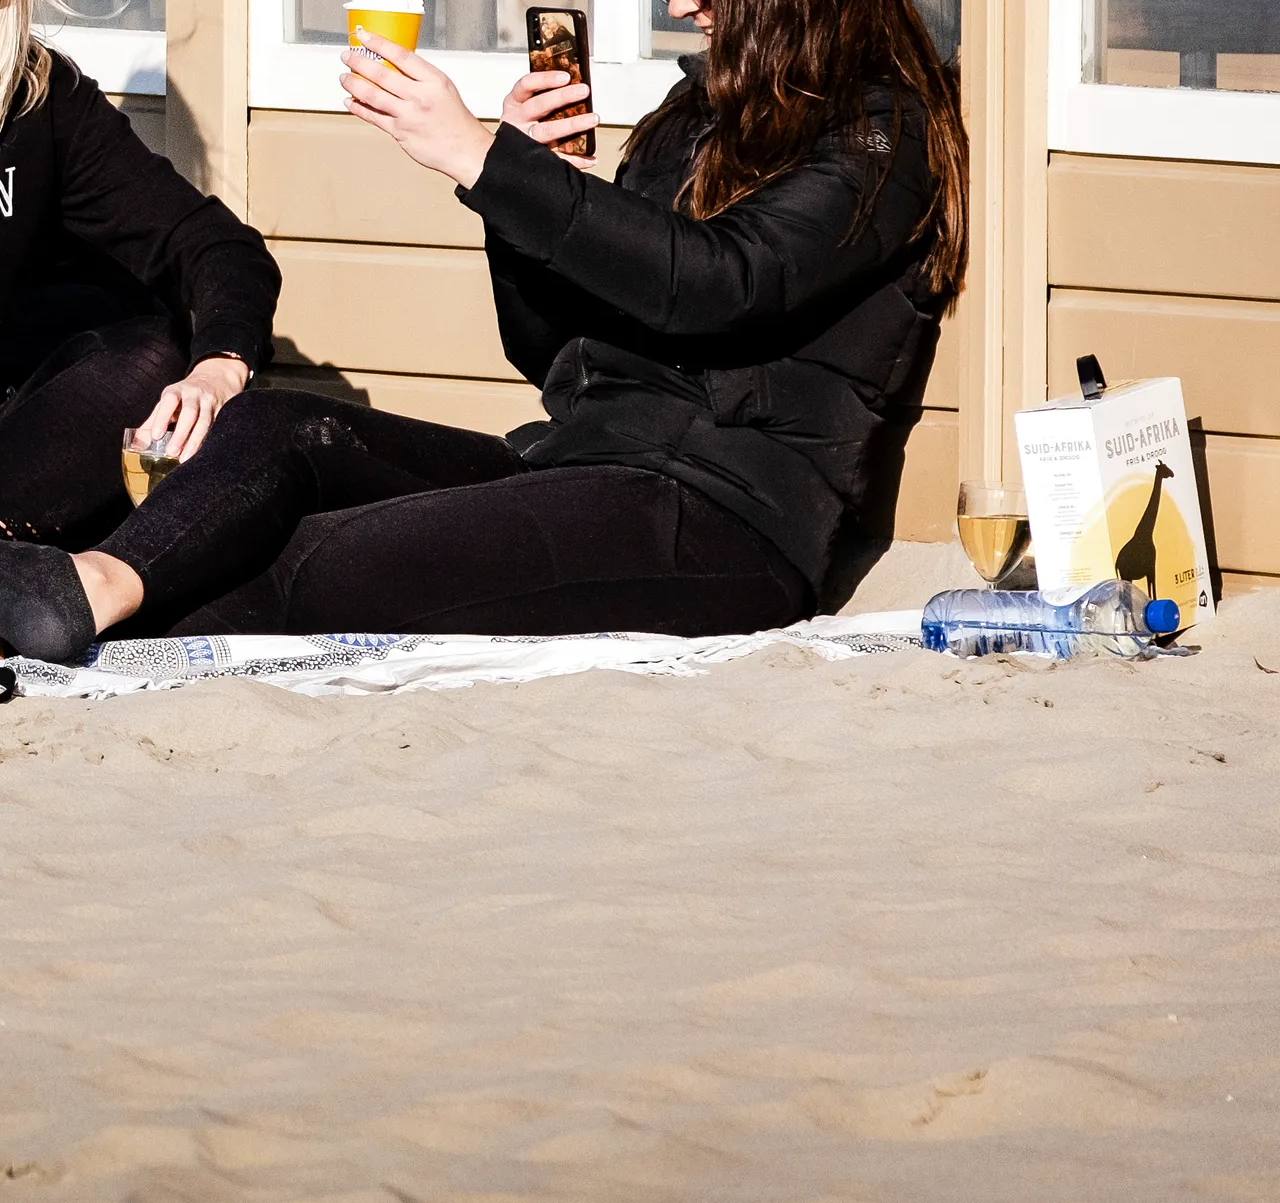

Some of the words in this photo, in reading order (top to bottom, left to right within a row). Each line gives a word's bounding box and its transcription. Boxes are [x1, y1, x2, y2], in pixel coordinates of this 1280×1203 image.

[1105, 417, 1180, 459] SUID-AFRIKA
[1024, 440, 1092, 455] SUID-AFRIKA
[1126, 456, 1140, 467] FRIS
[1179, 568, 1195, 583] LITER
